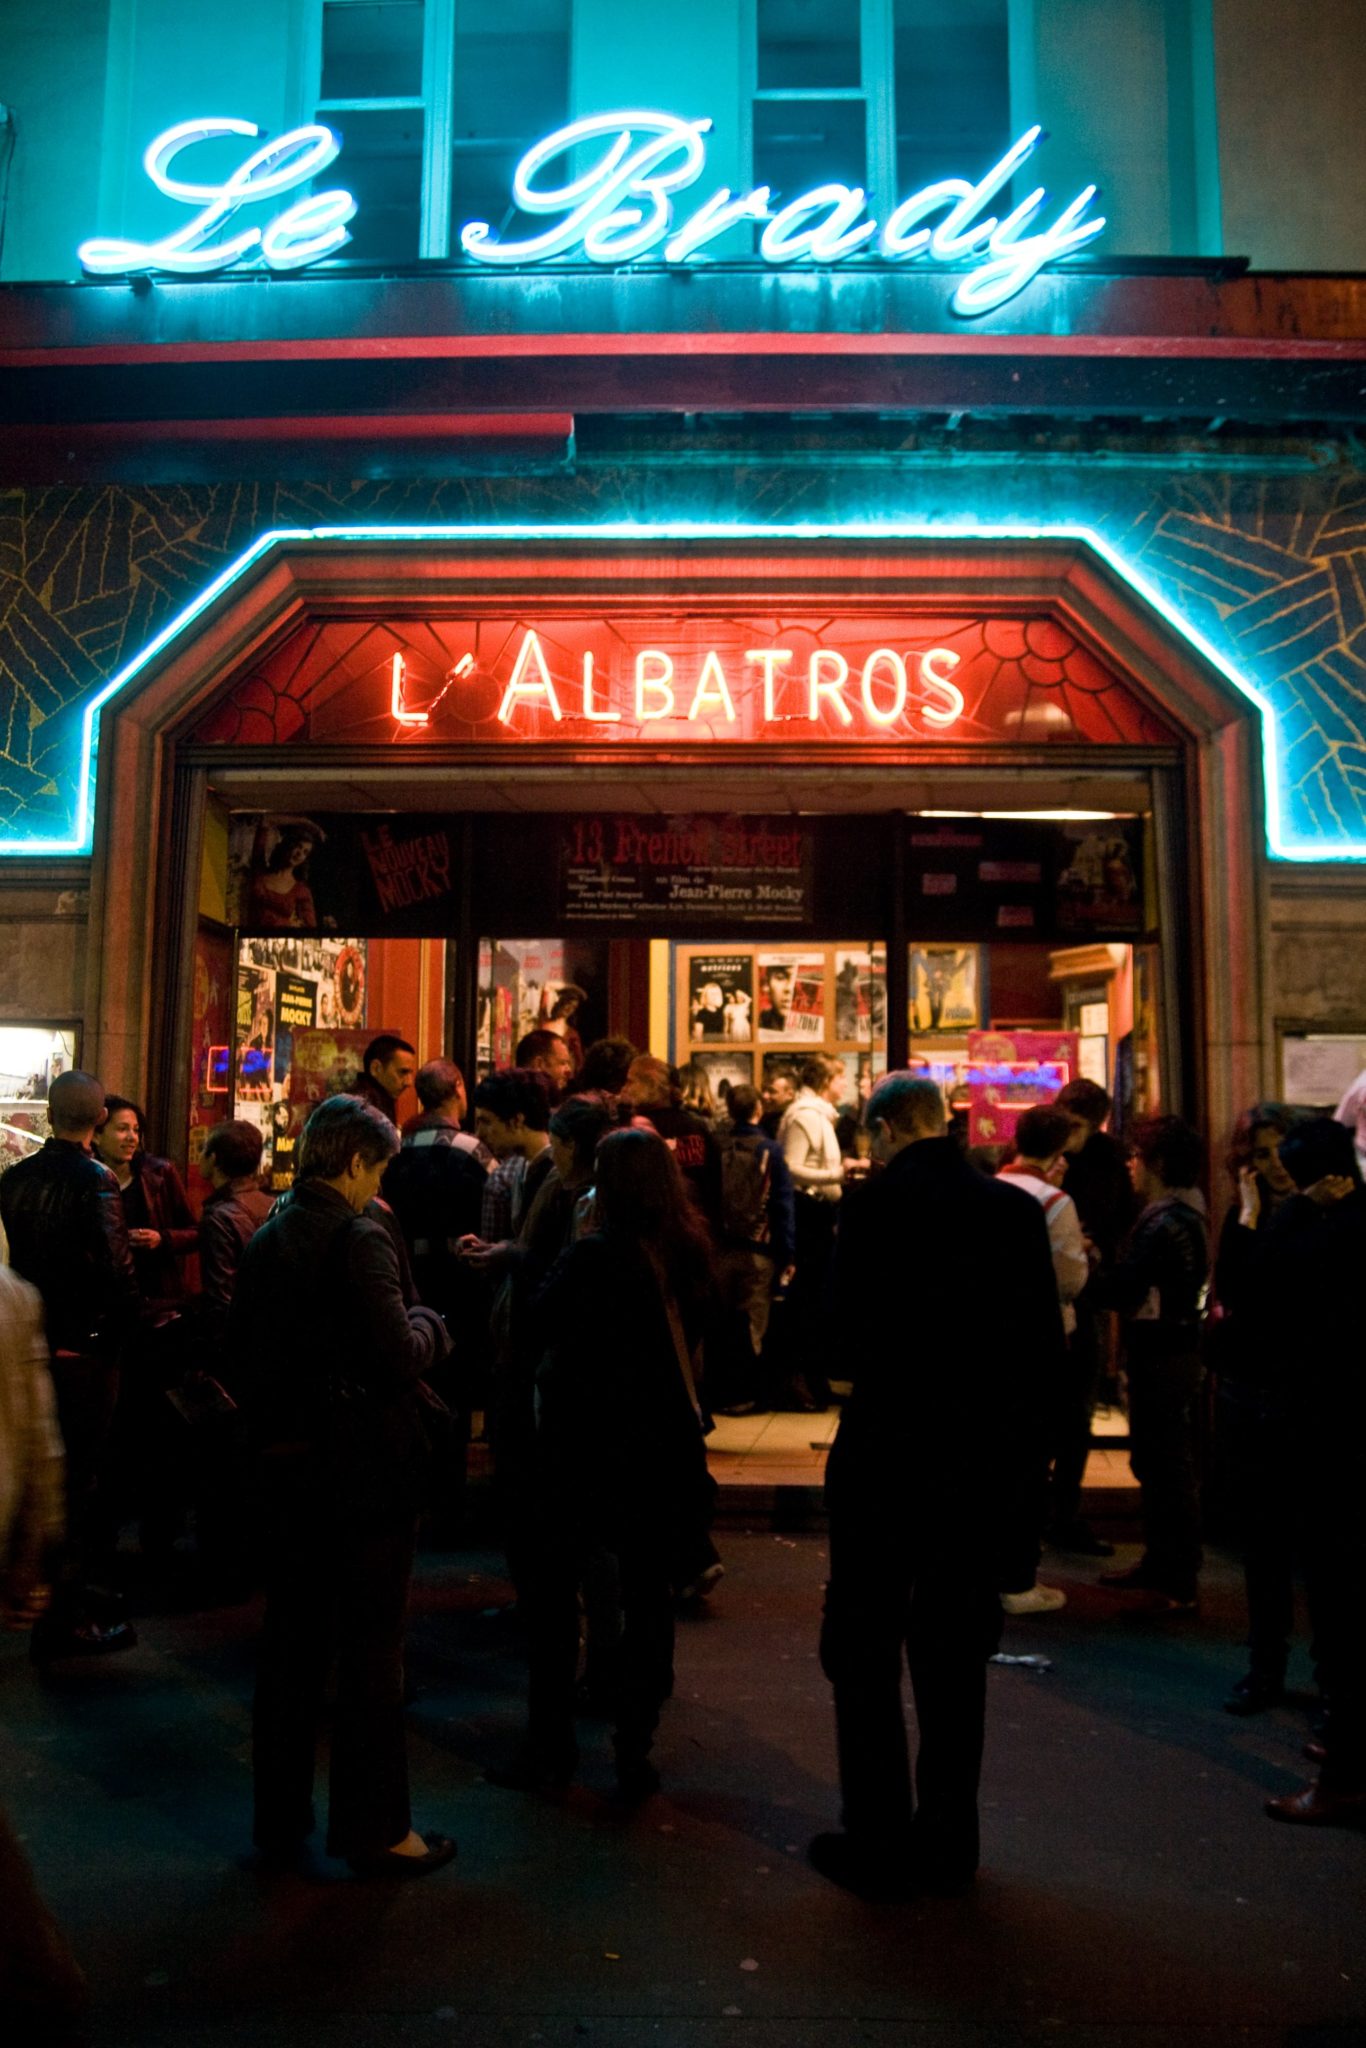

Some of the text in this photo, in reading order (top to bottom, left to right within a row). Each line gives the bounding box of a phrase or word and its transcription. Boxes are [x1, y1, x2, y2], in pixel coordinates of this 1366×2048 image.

[78, 111, 1106, 318] Le Brady
[368, 831, 449, 875] NOUVEAU
[573, 819, 604, 865] 13
[612, 819, 710, 865] French
[375, 860, 453, 913] MOCKY
[669, 884, 804, 902] Jean-Pierre Mocky
[280, 1006, 313, 1027] MOCKY
